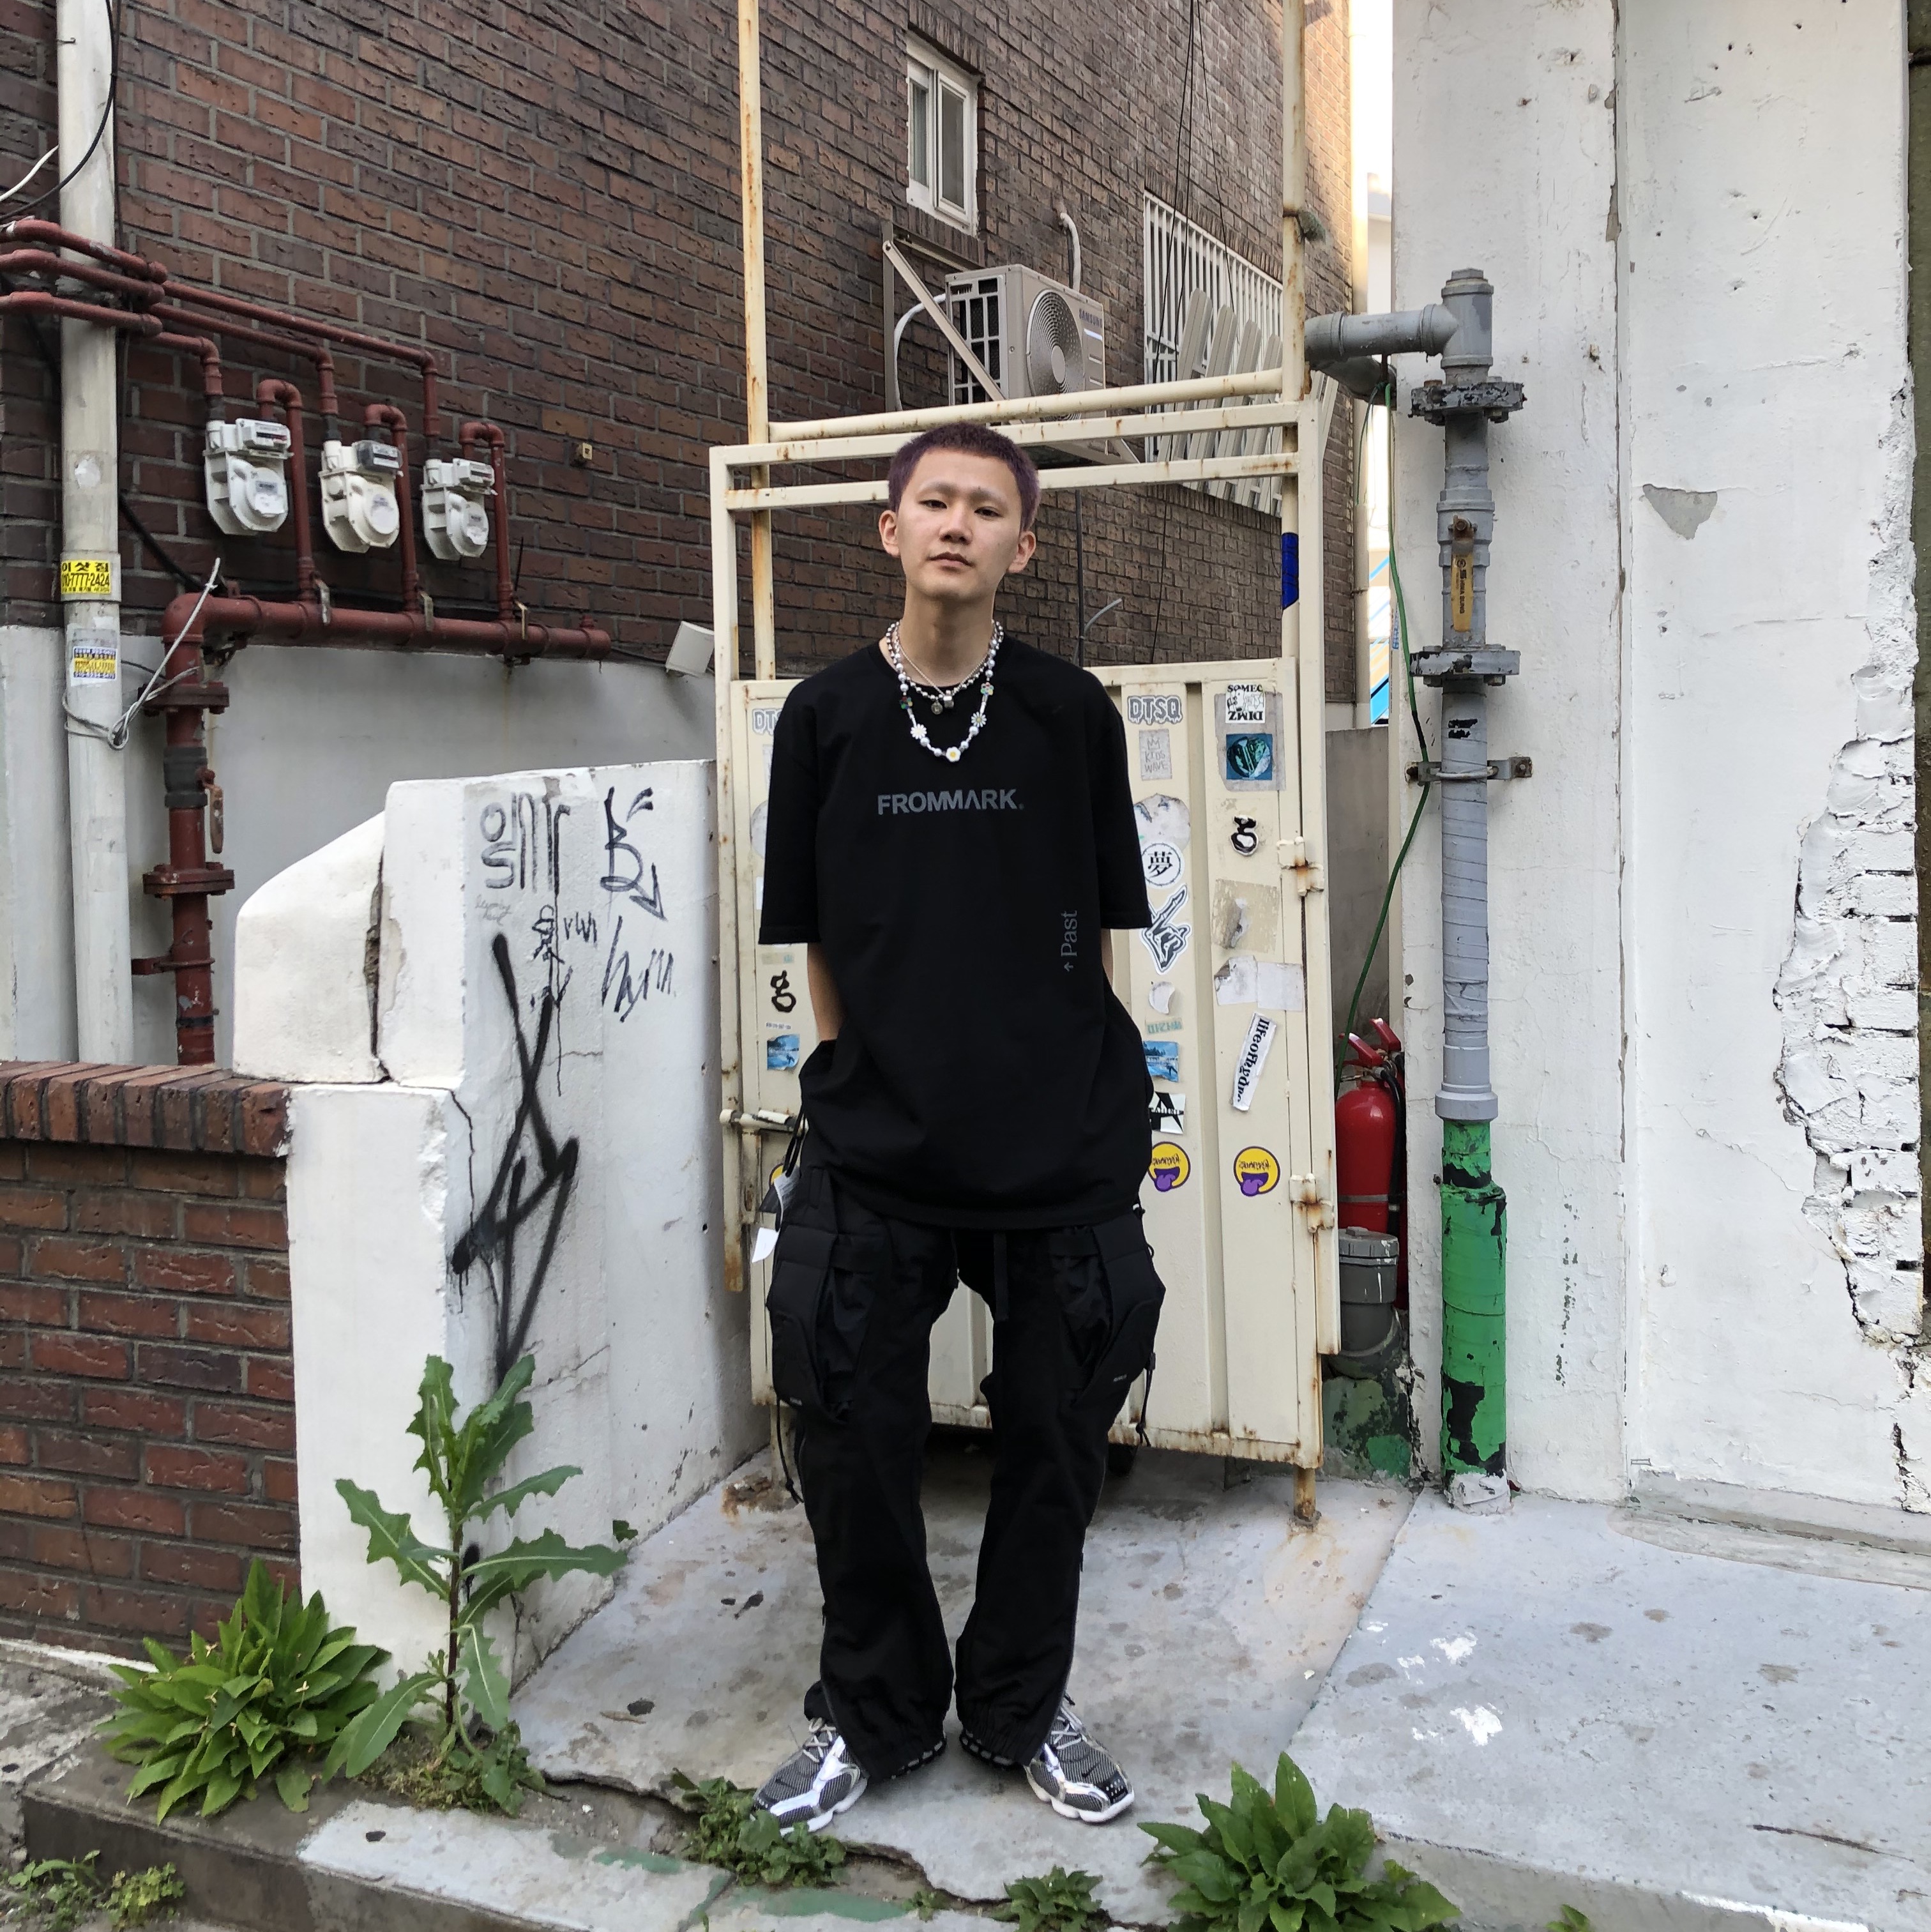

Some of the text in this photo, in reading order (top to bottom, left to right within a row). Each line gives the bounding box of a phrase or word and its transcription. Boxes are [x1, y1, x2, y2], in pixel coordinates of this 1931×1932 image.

[753, 710, 781, 731] DT
[1129, 697, 1181, 724] DTSQ
[1145, 751, 1165, 764] KIDS
[1145, 764, 1166, 773] WAVE
[1061, 910, 1077, 957] Past
